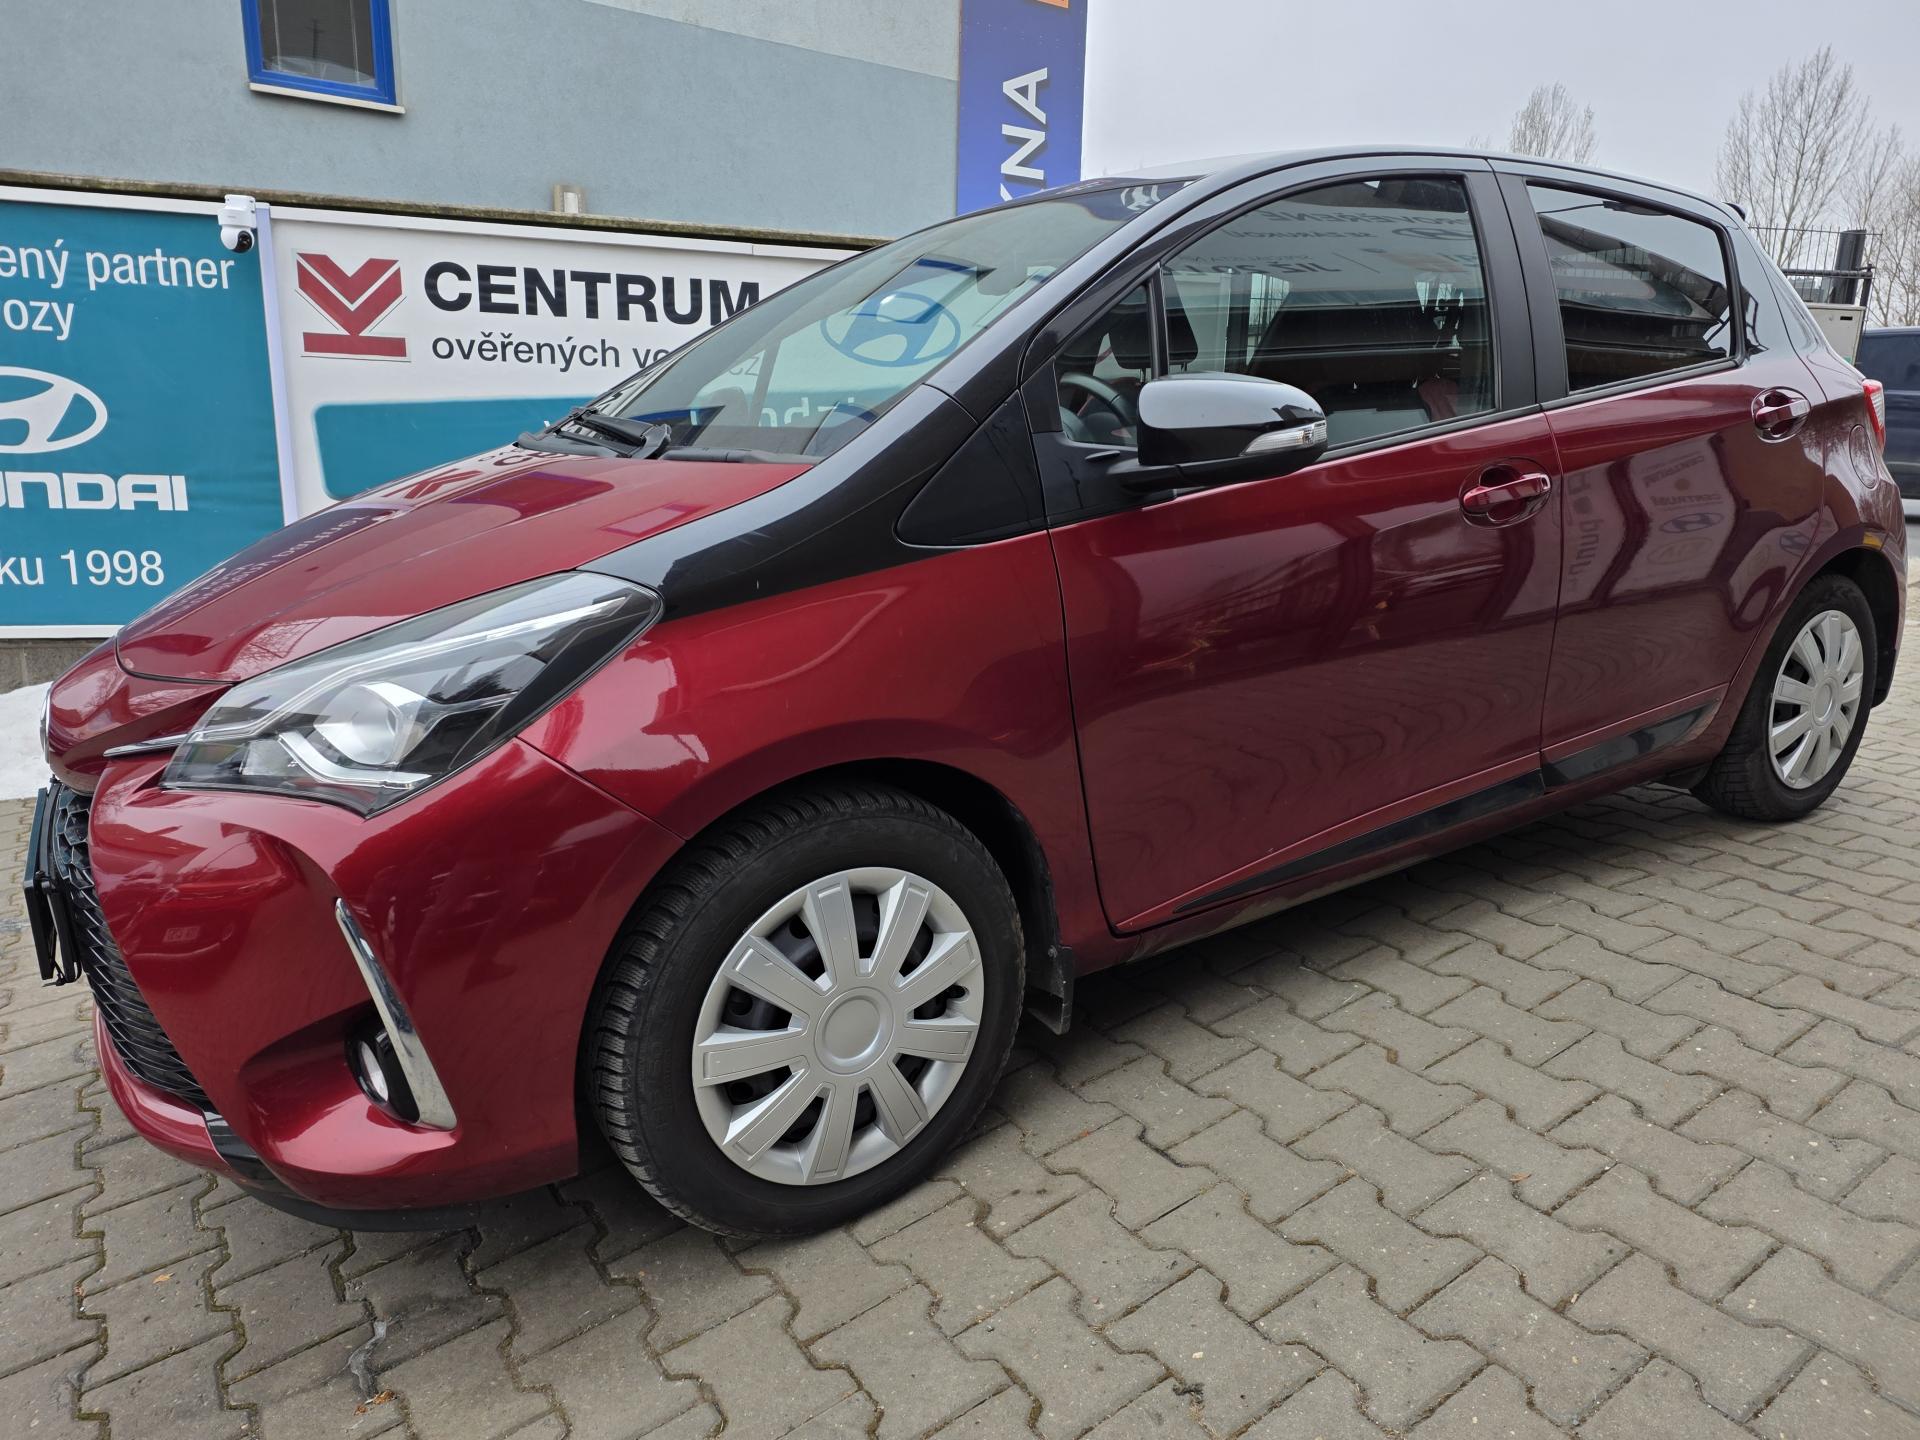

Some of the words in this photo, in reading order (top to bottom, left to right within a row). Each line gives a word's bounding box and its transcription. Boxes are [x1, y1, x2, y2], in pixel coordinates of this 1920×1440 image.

[1000, 67, 1048, 201] NA
[86, 248, 235, 291] partner
[424, 261, 761, 327] CENTRUM
[3, 299, 74, 341] ozy
[432, 331, 620, 373] ověřených
[0, 471, 189, 511] NDAI
[60, 549, 165, 586] 1998
